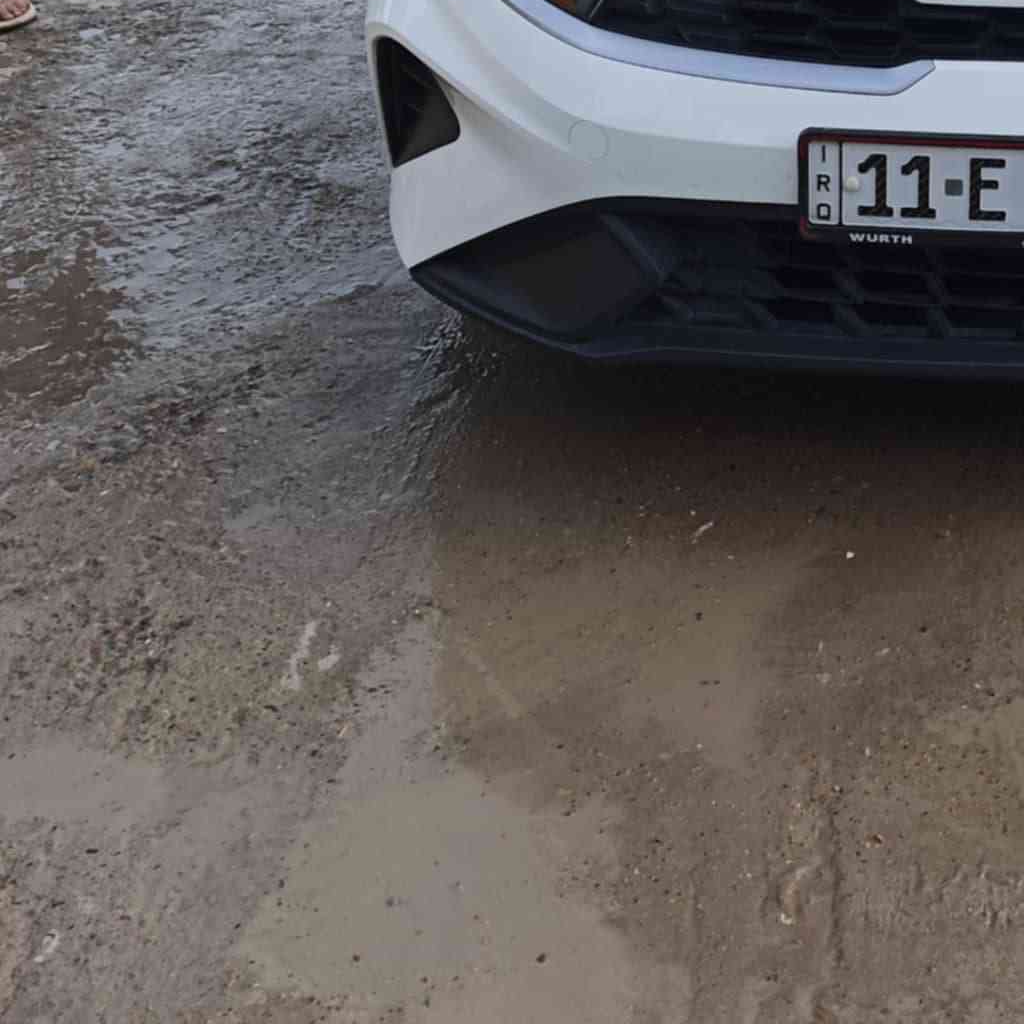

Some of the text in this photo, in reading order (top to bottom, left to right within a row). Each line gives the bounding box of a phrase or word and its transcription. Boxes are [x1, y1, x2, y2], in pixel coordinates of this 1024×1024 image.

[857, 153, 937, 219] 11
[969, 158, 1007, 222] E
[849, 232, 913, 244] WURTH
